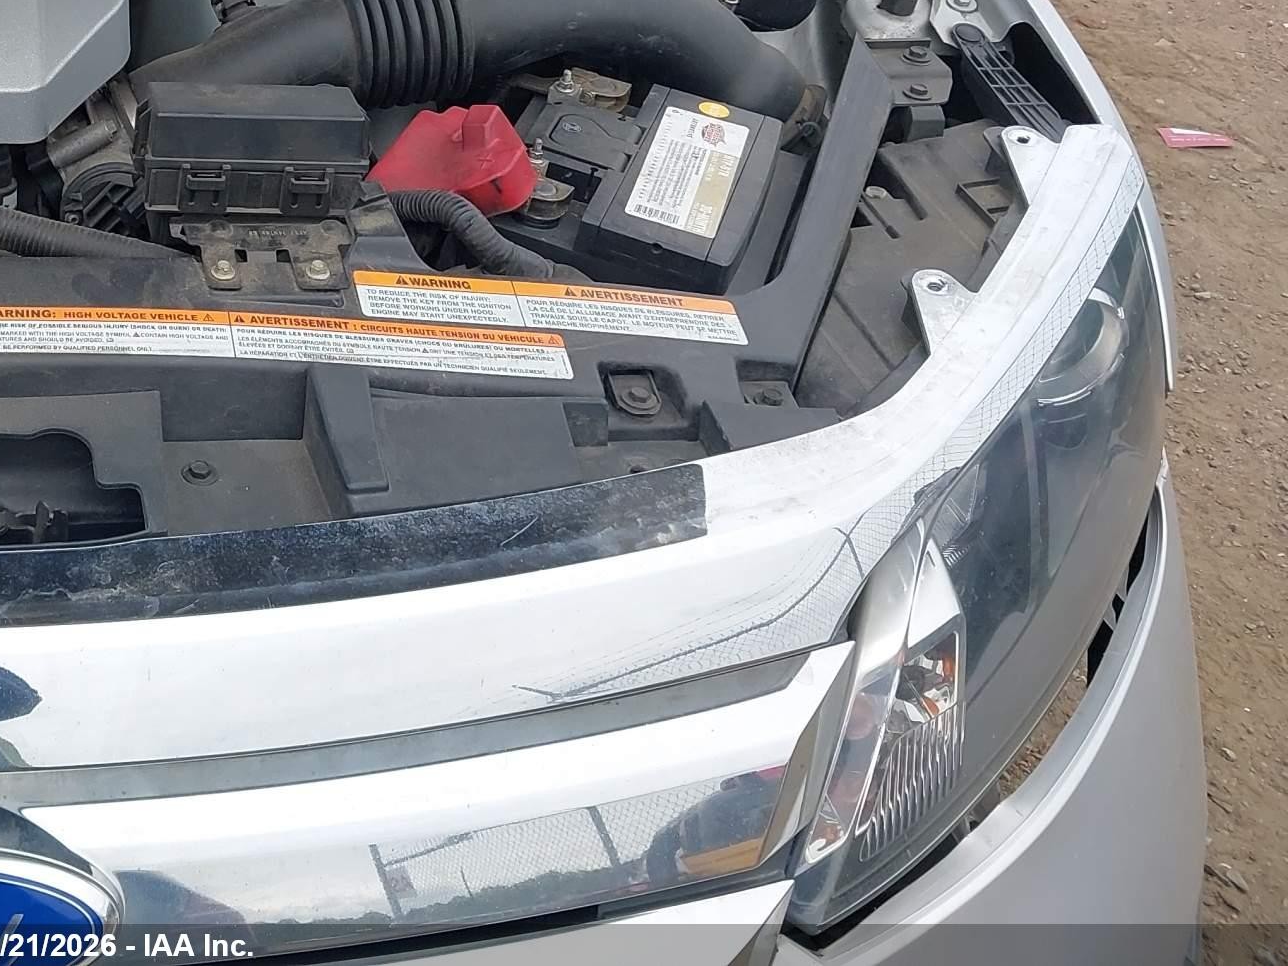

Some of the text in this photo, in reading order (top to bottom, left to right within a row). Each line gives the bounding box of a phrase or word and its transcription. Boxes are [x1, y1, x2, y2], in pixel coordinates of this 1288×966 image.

[408, 277, 471, 290] WARNING
[379, 289, 410, 297] REDUCE
[368, 295, 401, 303] REMOVE
[580, 289, 683, 307] AVERTISSEMENT
[402, 304, 440, 312] WORKING
[96, 312, 147, 320] VOLTAGE
[151, 313, 198, 321] VEHICLE
[250, 315, 350, 330] AVERTISSEMENT
[360, 325, 404, 334] CIRCUITS
[407, 327, 436, 336] HAUTE
[439, 330, 480, 340] TENSION
